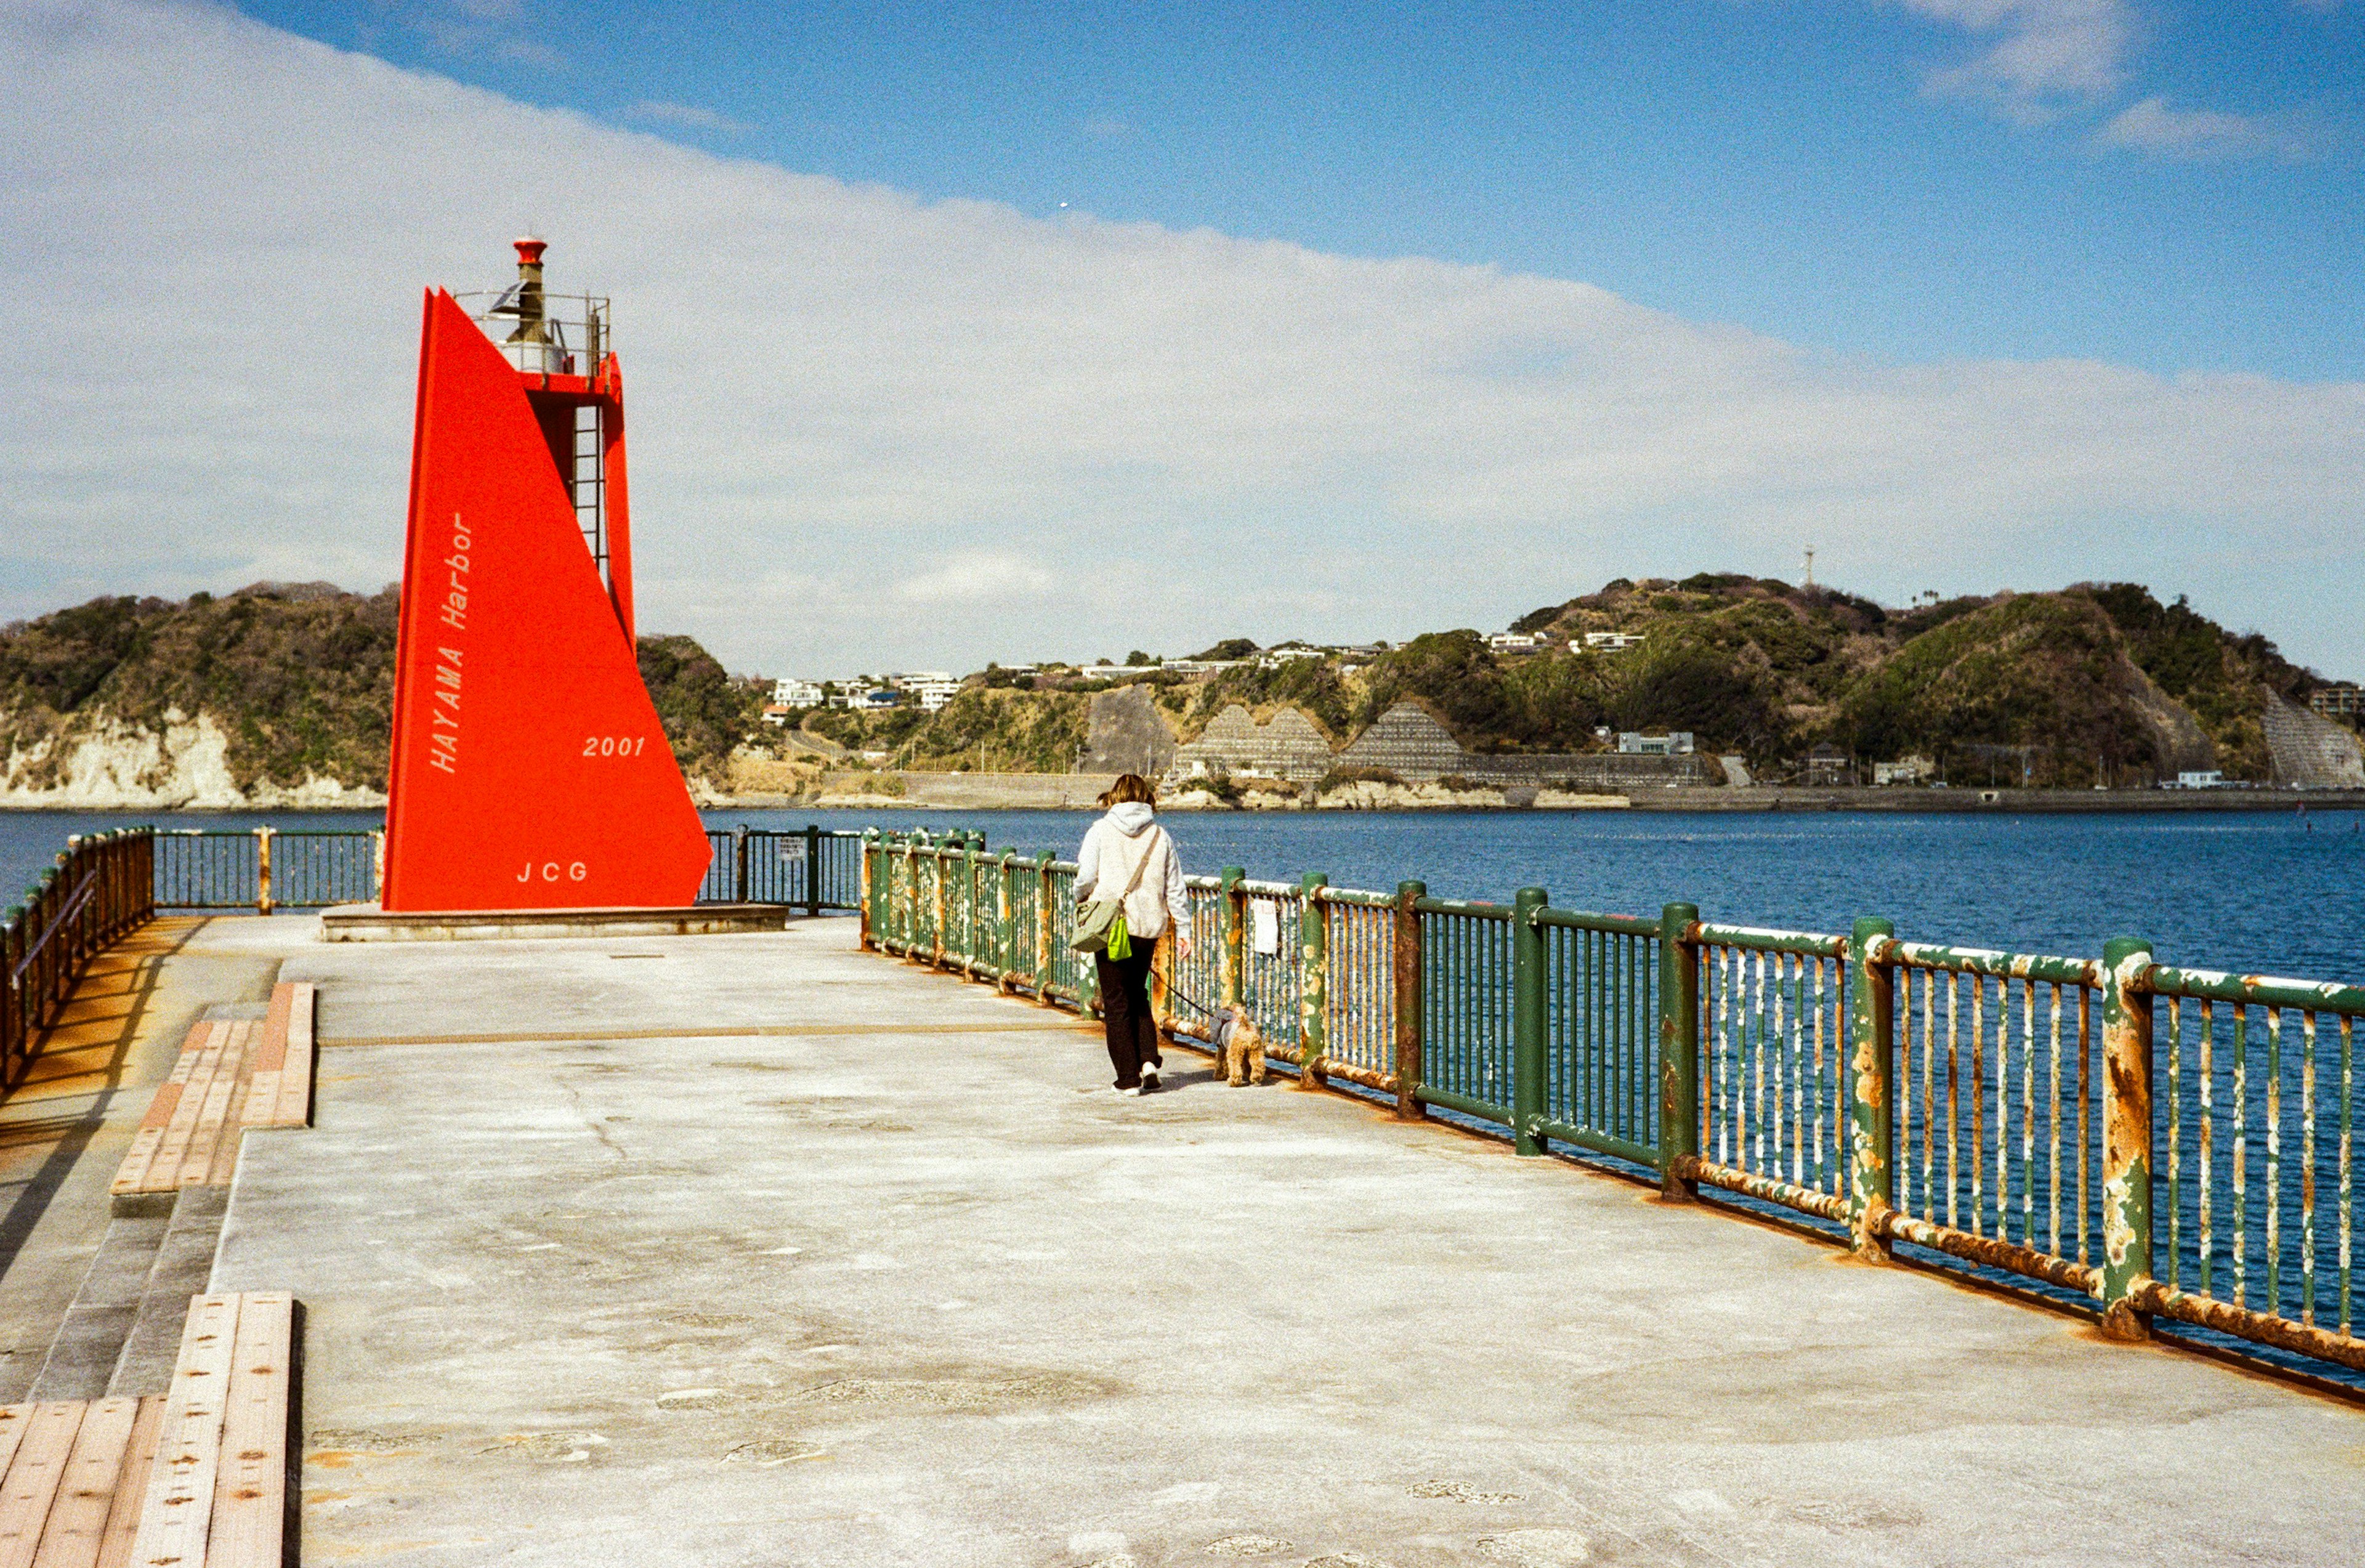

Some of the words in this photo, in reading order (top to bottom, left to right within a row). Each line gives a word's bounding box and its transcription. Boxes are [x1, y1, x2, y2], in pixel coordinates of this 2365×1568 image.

[441, 513, 472, 630] Harbor
[431, 647, 465, 773] HAYAMA
[582, 737, 645, 757] 2001
